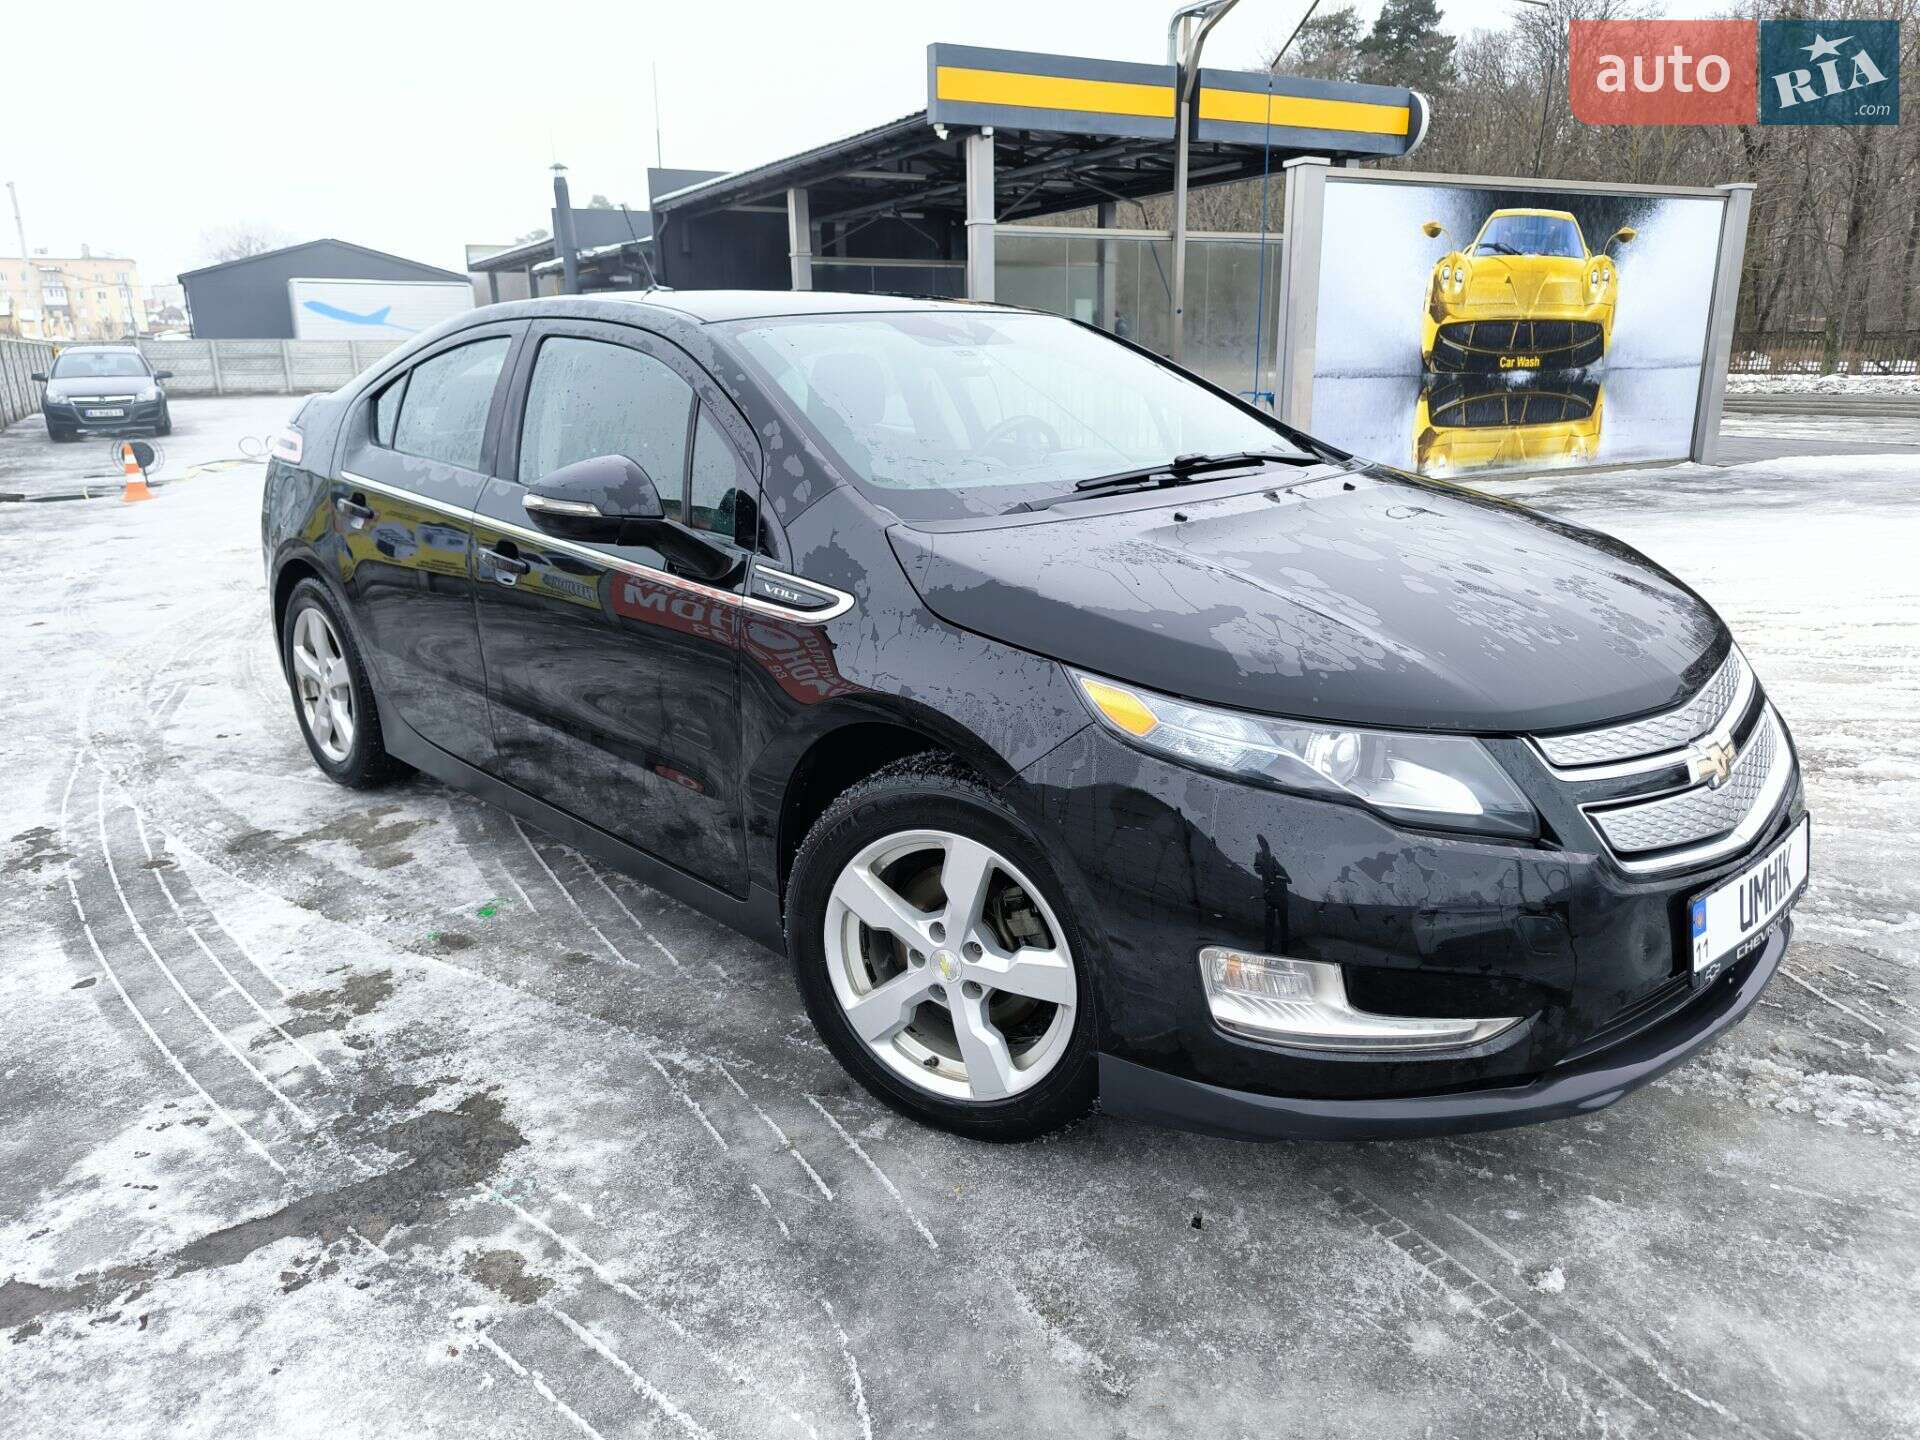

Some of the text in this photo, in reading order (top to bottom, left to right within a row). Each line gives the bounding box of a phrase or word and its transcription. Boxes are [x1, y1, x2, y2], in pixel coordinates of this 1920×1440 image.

[1499, 356, 1540, 368] Car Wash
[764, 582, 801, 601] VOLT
